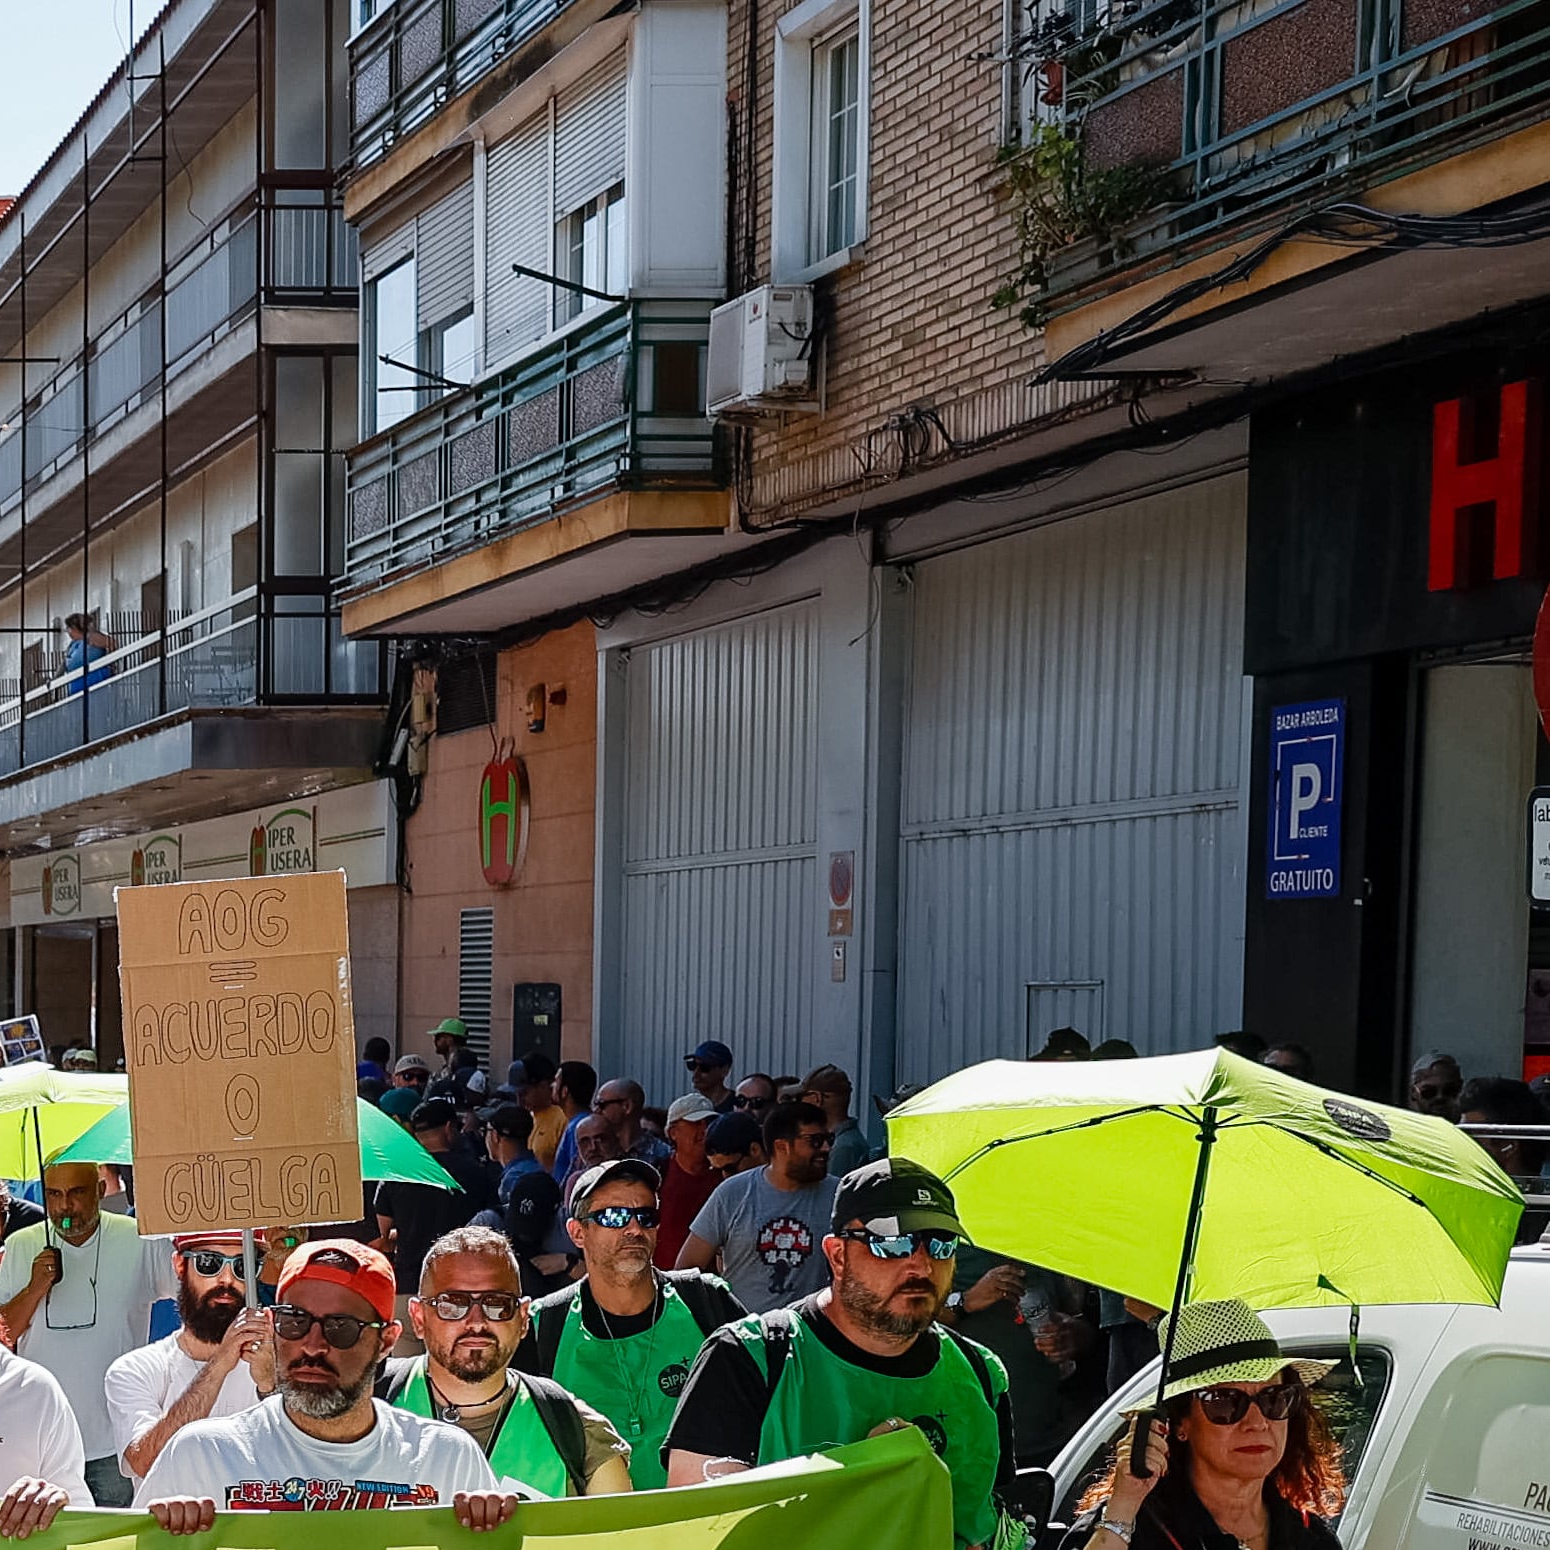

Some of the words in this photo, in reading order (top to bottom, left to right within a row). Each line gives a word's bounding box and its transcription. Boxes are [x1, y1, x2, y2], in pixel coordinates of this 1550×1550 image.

[1276, 712, 1300, 731] BAZAR
[1301, 707, 1339, 728] ARBOLEDA
[1289, 763, 1322, 840] P
[1299, 825, 1328, 838] CLIENTE
[270, 847, 312, 872] USERA
[1270, 868, 1333, 892] GRATUITO
[178, 888, 289, 954] AOG
[134, 990, 335, 1066] ACUERDO
[225, 1073, 260, 1136] O
[163, 1153, 340, 1224] GÜELGA
[661, 1372, 687, 1389] SIPA
[1524, 1482, 1550, 1512] PA
[1457, 1512, 1550, 1547] REHABILITACIONES
